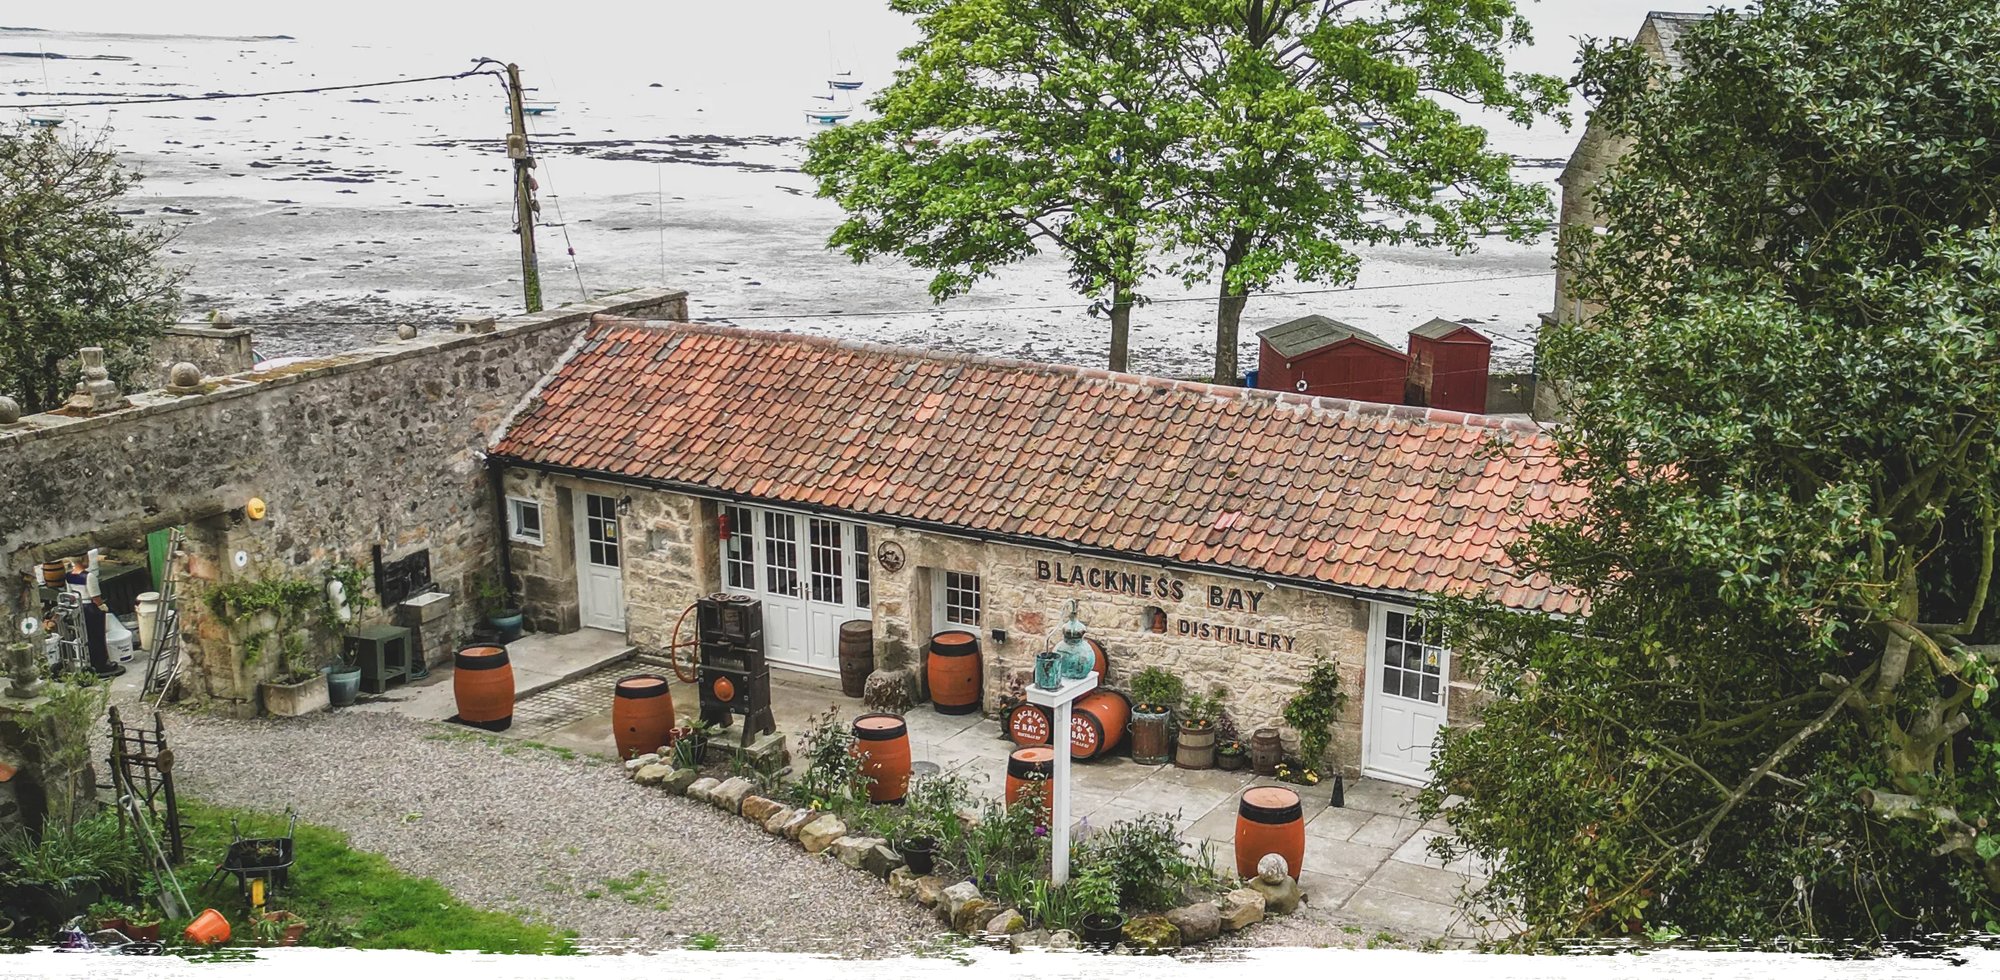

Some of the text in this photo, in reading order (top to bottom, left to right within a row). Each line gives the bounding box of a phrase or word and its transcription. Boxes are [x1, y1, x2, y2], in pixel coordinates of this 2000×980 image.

[1036, 560, 1264, 614] BLACKNESS BAY
[1178, 619, 1295, 651] DISTILLERY
[1014, 710, 1046, 735] BLACKNESS
[1022, 724, 1038, 733] BAY
[1071, 731, 1086, 741] BAY
